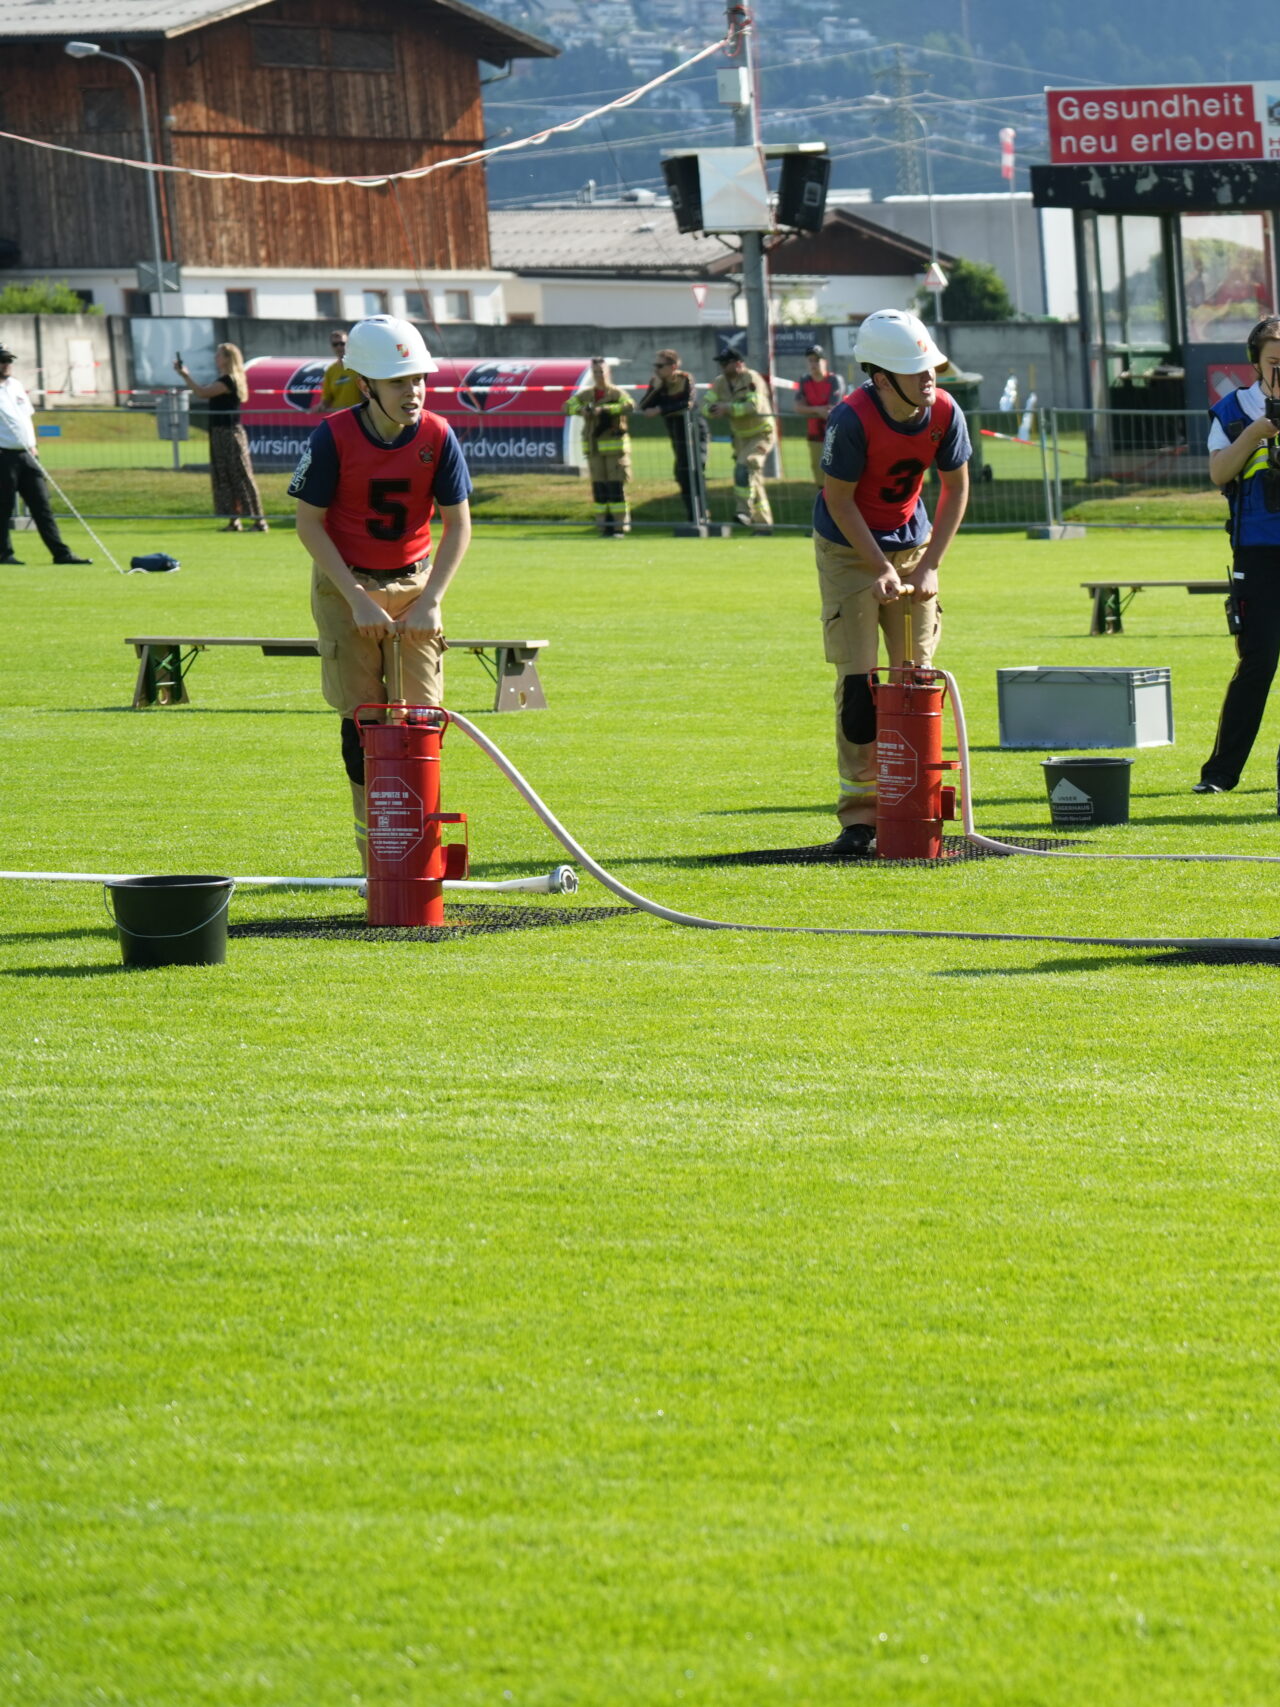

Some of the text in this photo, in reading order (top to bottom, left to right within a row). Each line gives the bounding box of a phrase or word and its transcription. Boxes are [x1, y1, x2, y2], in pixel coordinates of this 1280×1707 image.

[1057, 93, 1244, 121] Gesundheit
[1060, 127, 1255, 153] neu erleben
[250, 436, 557, 458] wirsind ndvolders
[881, 458, 924, 503] 3
[367, 478, 411, 541] 5
